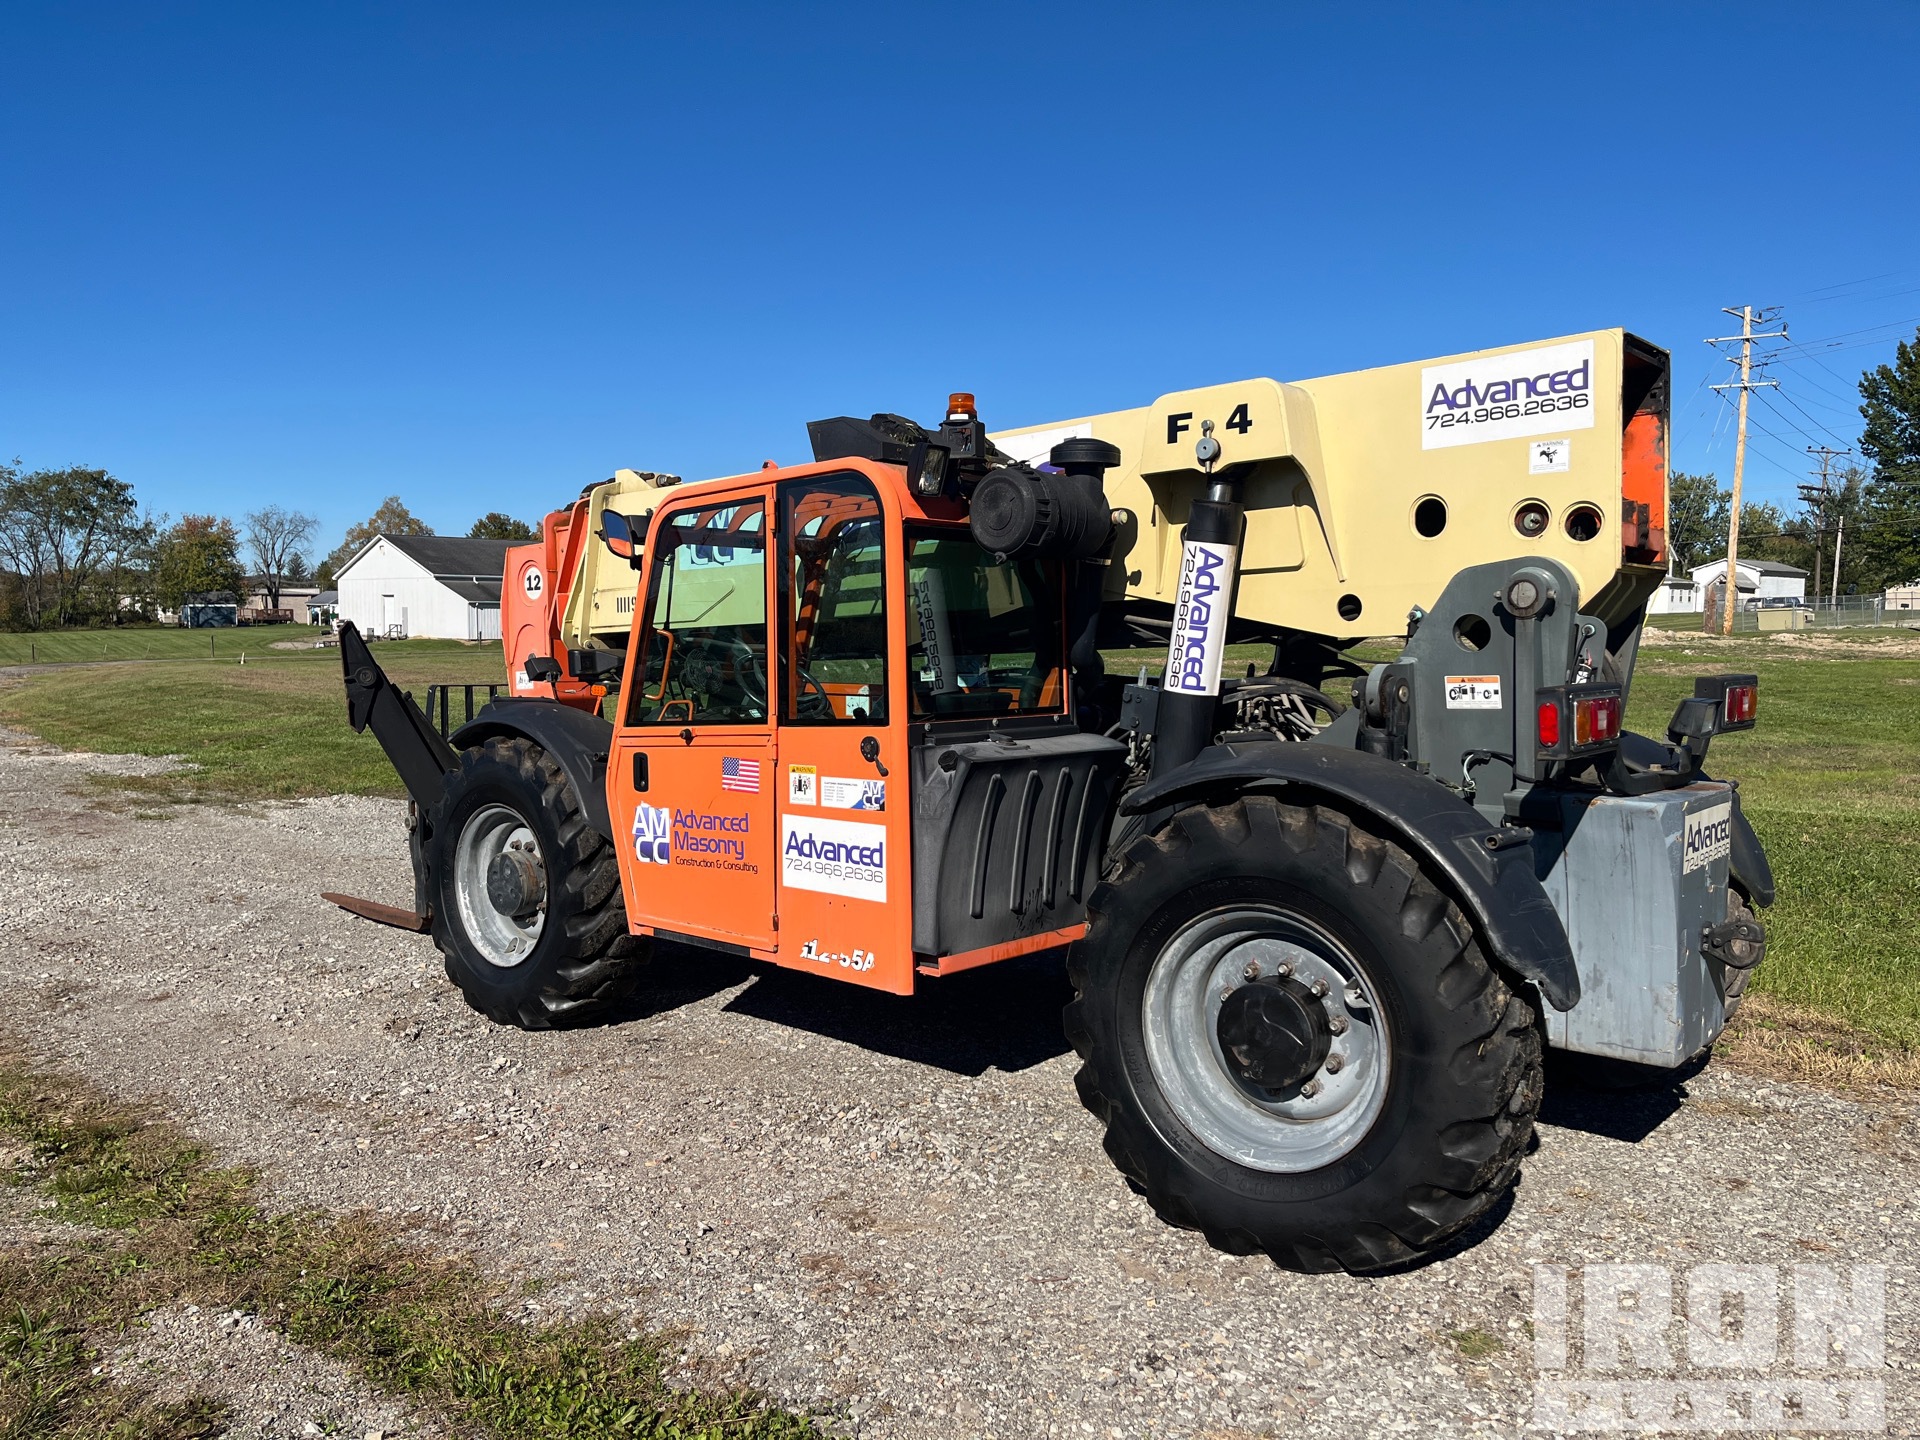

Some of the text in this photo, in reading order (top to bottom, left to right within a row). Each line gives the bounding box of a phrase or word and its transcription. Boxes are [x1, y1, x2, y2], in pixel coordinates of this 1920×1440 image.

[1426, 359, 1589, 414] Advanced
[1167, 403, 1253, 444] F 4
[1426, 393, 1589, 430] 724.966.2636
[526, 574, 541, 591] 12
[1169, 545, 1197, 688] 724.966.2636
[1181, 546, 1224, 691] Advanced
[673, 808, 749, 832] Advanced
[1685, 810, 1730, 856] Advanced
[674, 831, 744, 860] Masonry
[785, 830, 883, 868] Advanced
[675, 856, 758, 874] Construction & Consulting
[785, 857, 884, 883] 724.966.2636
